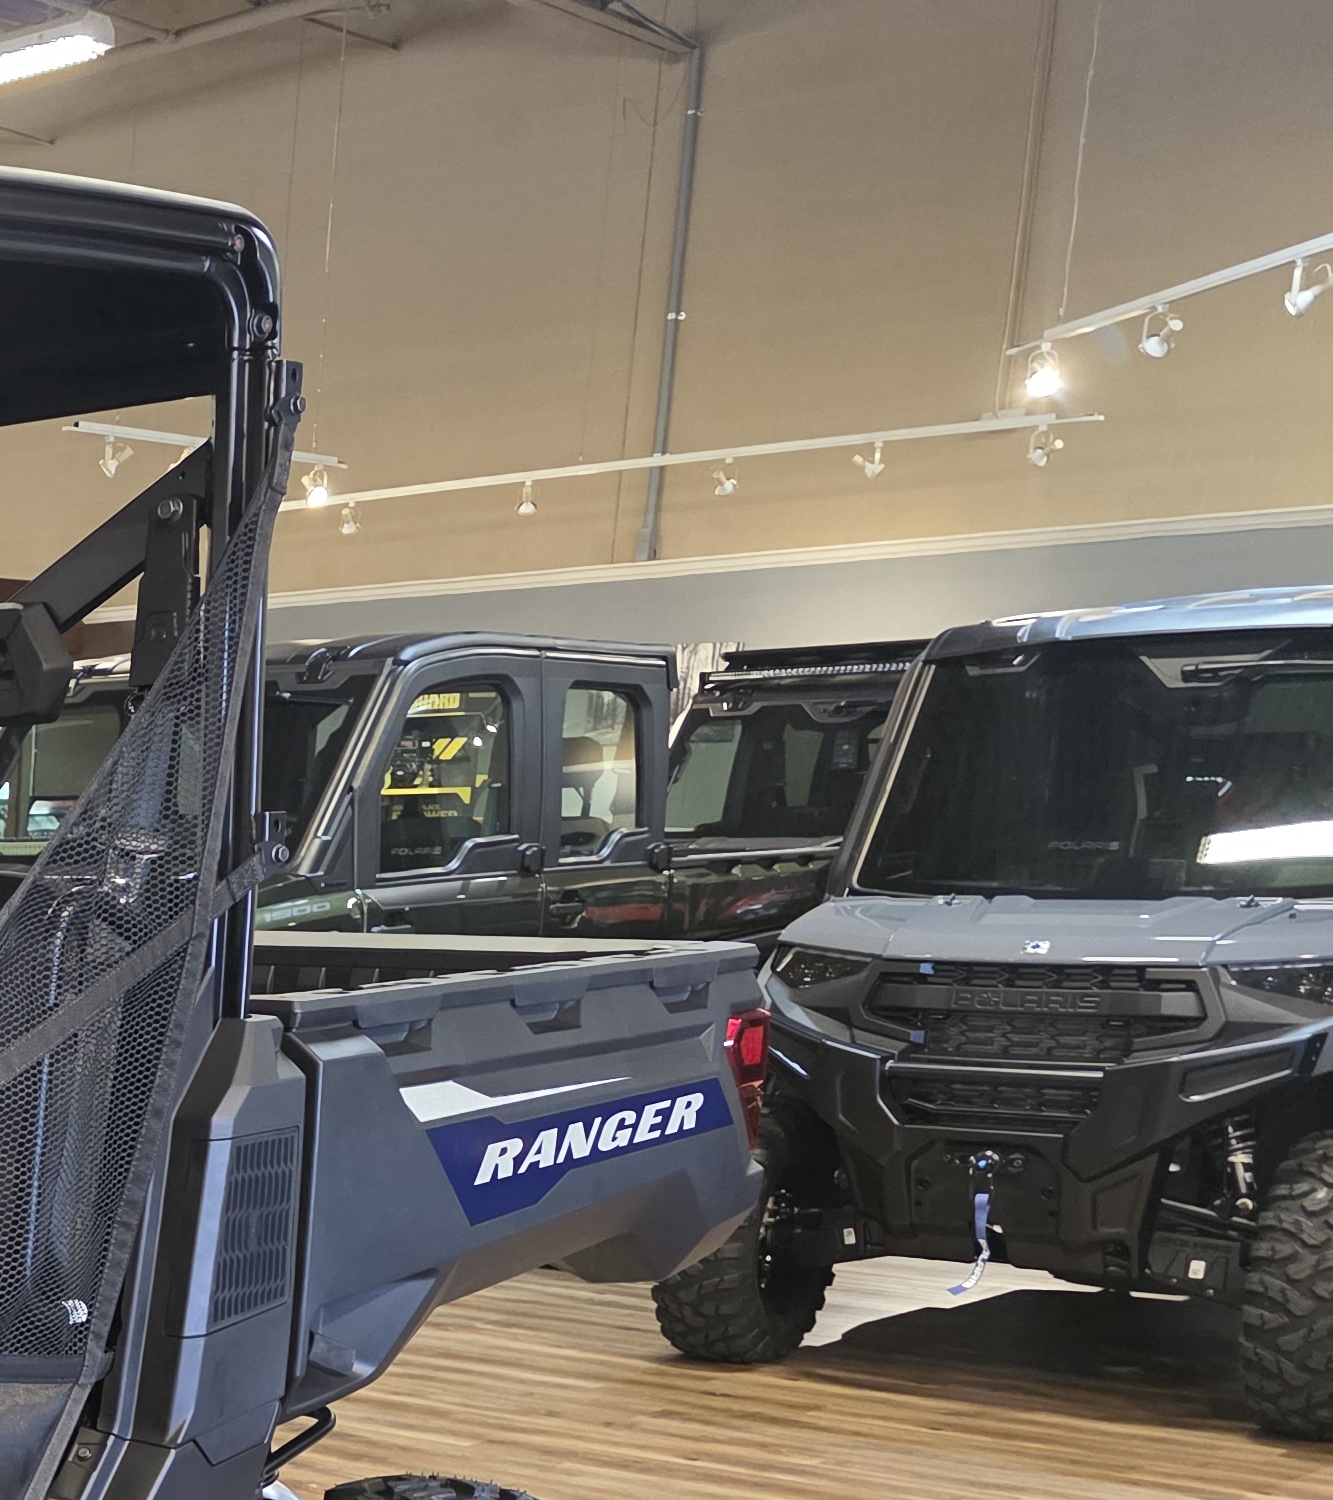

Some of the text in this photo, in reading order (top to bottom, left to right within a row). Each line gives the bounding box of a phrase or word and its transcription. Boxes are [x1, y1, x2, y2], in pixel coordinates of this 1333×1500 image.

[391, 847, 442, 856] POLARIS
[1047, 841, 1120, 850] POLARIS
[263, 902, 331, 922] 1500
[951, 993, 1101, 1012] POLARIS
[474, 1091, 705, 1187] RANGER
